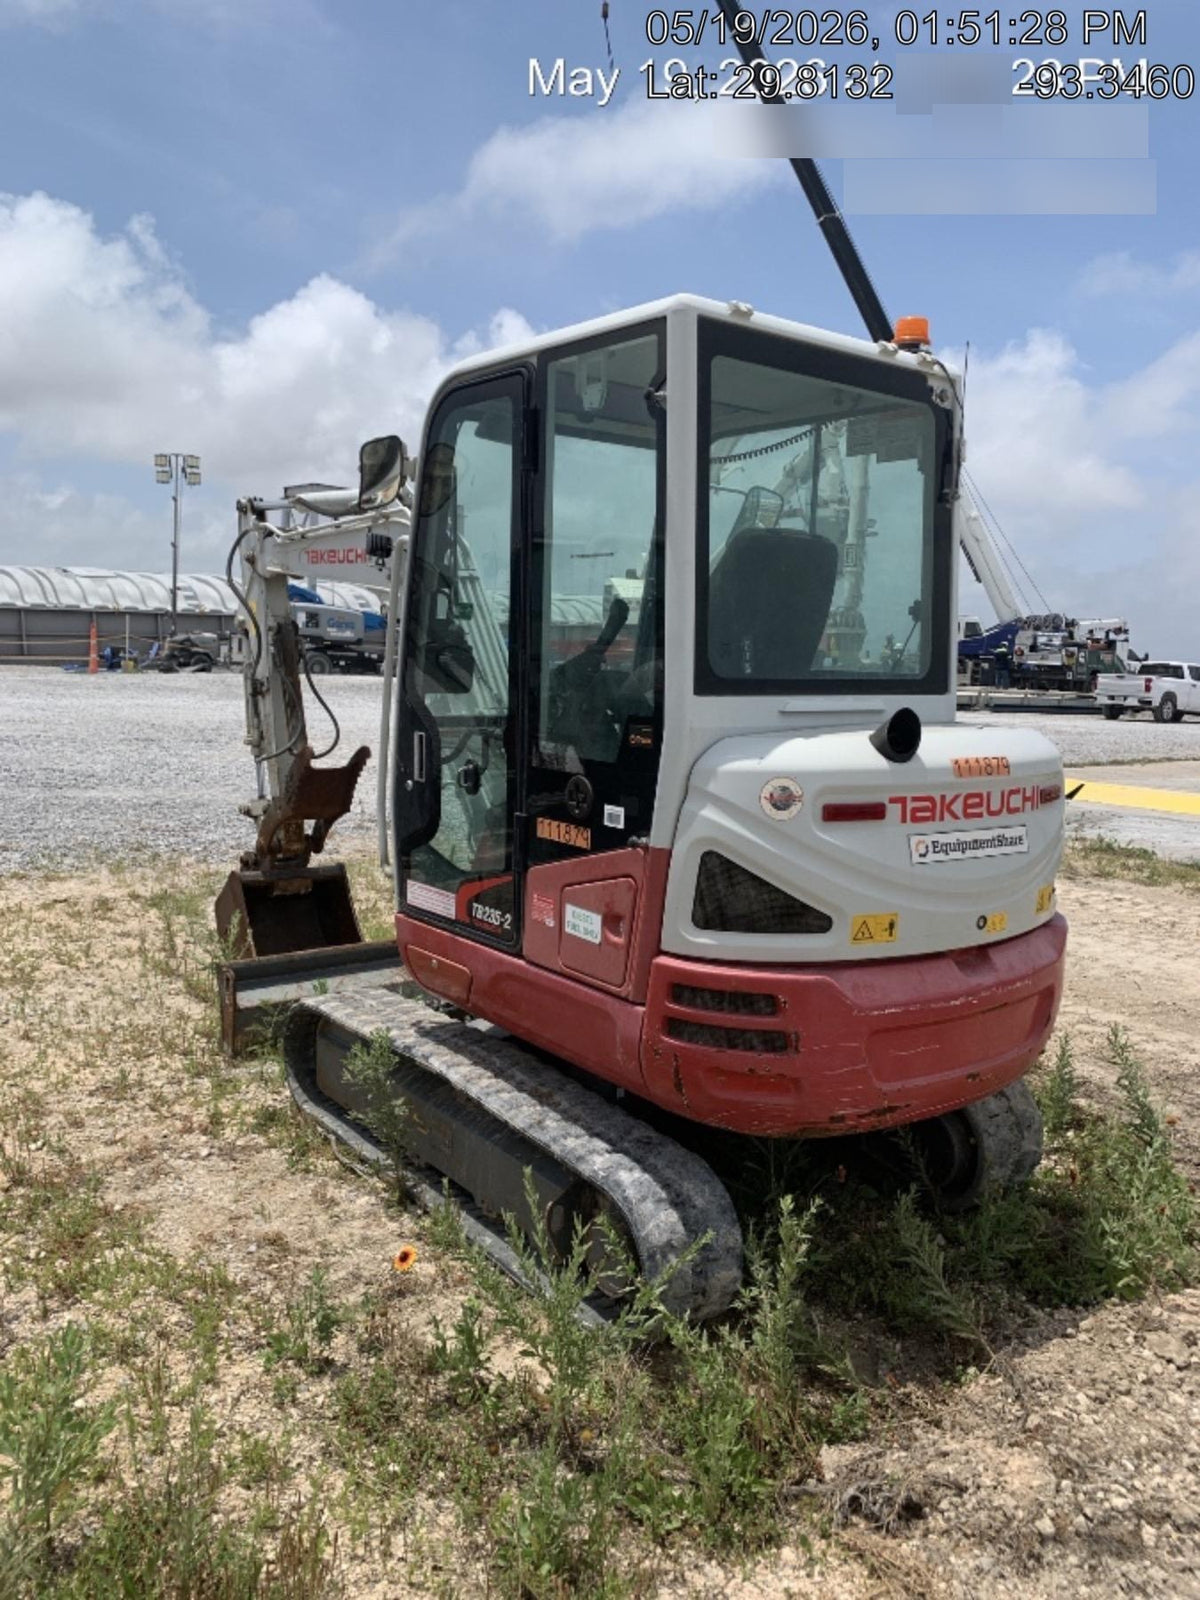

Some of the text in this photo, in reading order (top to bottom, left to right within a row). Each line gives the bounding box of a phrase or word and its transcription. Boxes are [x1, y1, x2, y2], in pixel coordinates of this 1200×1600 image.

[953, 756, 1010, 778] 111879
[888, 784, 1040, 824] TAKEUCHI
[538, 819, 590, 847] 111879
[931, 833, 1024, 855] EquipmentShare
[472, 902, 512, 930] TB235-2
